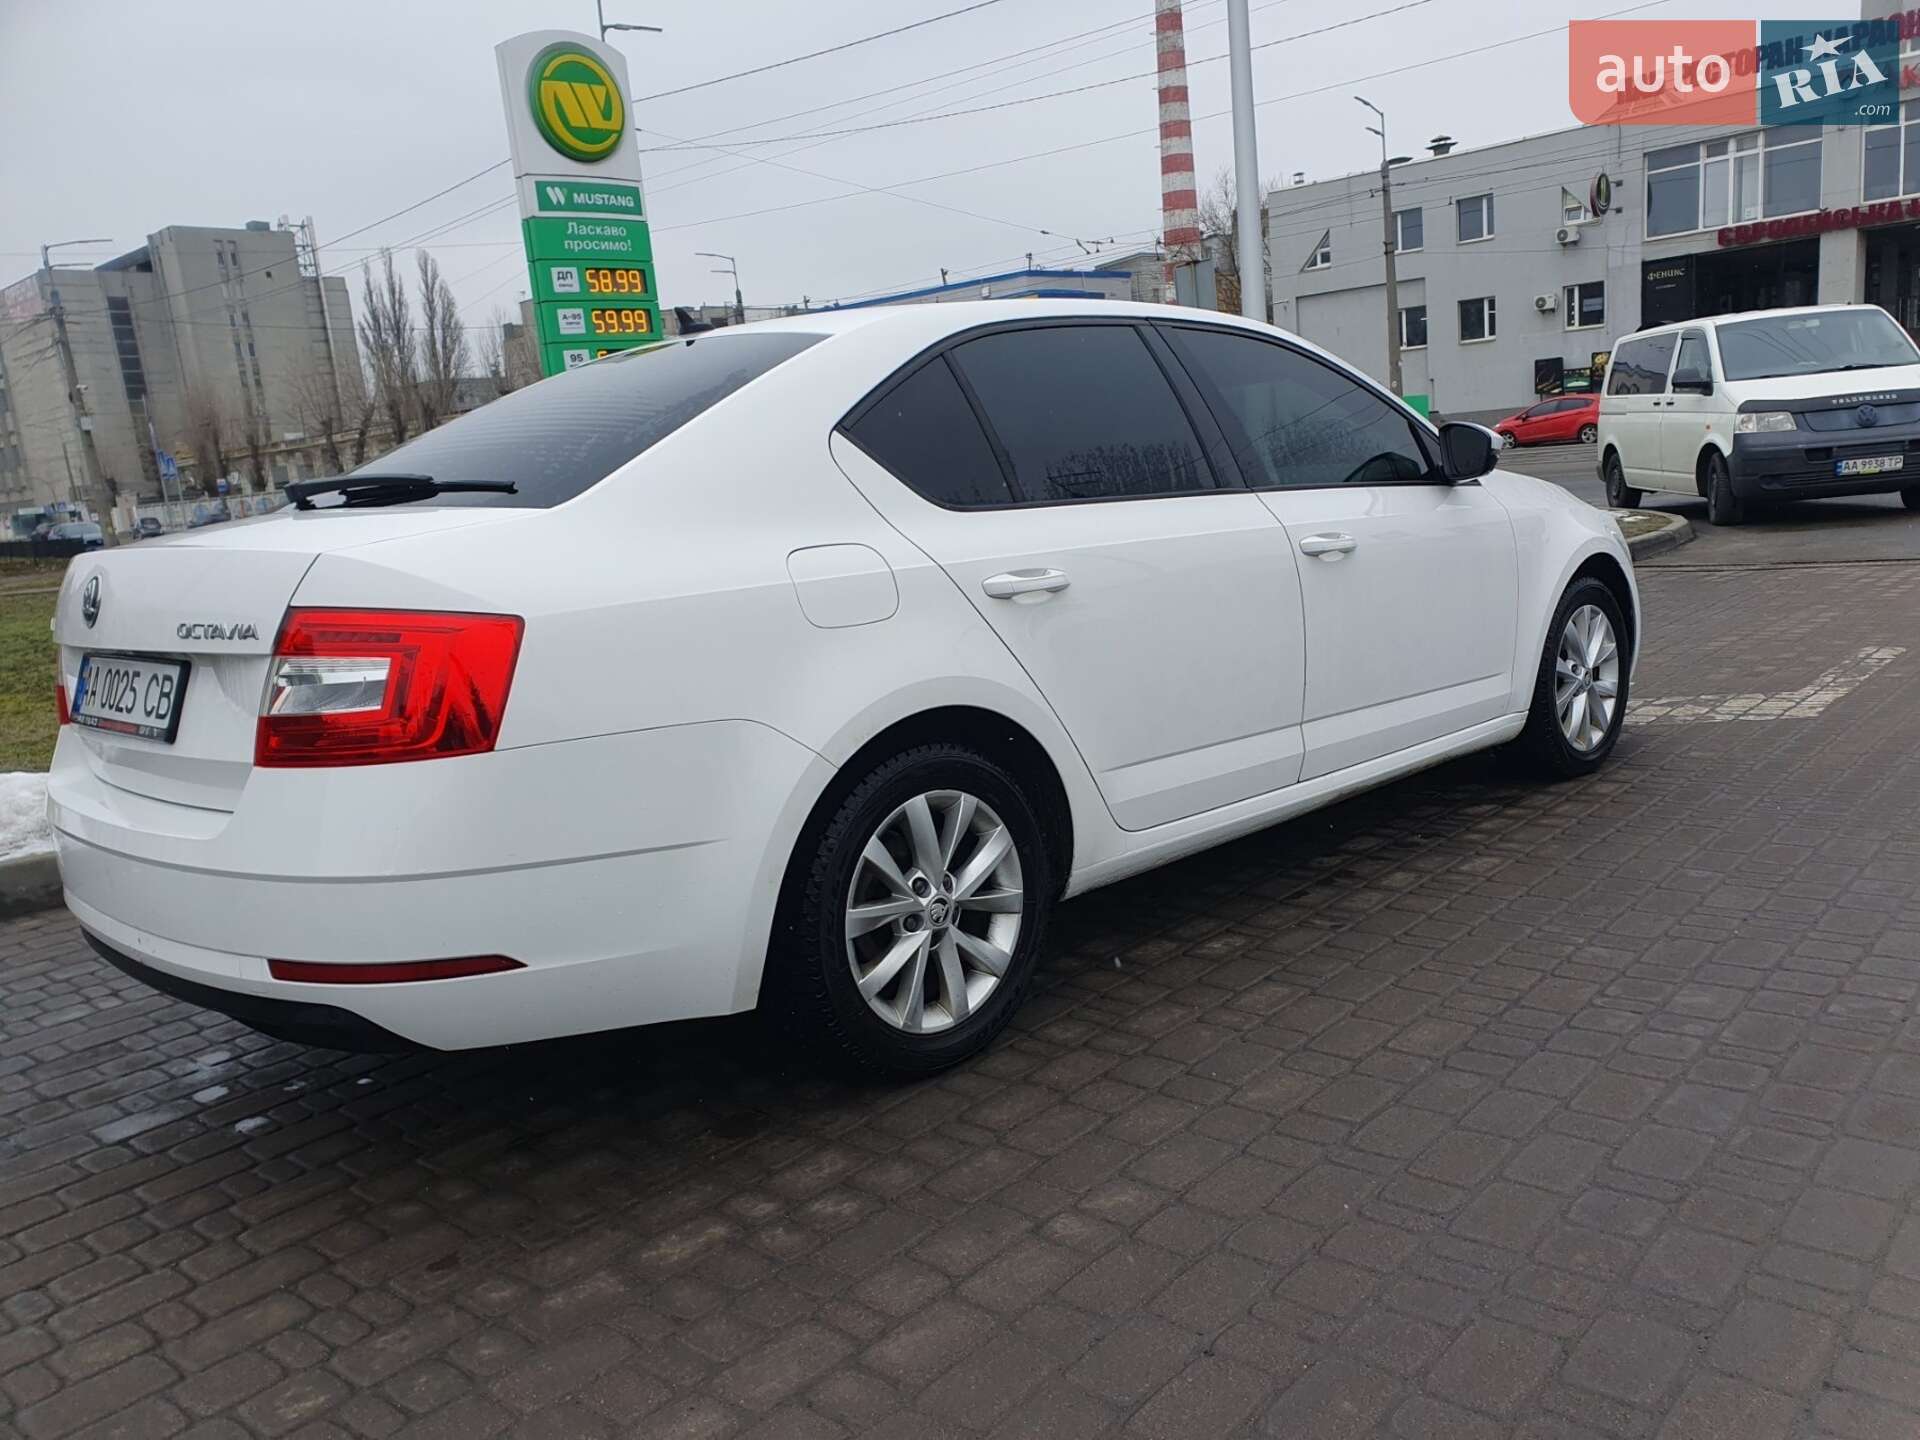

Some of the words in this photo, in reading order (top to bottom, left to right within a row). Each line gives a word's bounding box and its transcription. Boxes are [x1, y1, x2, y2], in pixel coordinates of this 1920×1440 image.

[573, 193, 635, 207] MUSTANG
[567, 221, 626, 236] Ласкаво
[564, 239, 632, 252] просимо!
[557, 271, 573, 281] ДП
[585, 270, 642, 292] 58.99
[592, 310, 648, 333] 59.99
[569, 354, 584, 363] 95
[177, 623, 259, 640] OCTAVIA
[100, 668, 140, 714] 0025
[144, 673, 174, 720] CB
